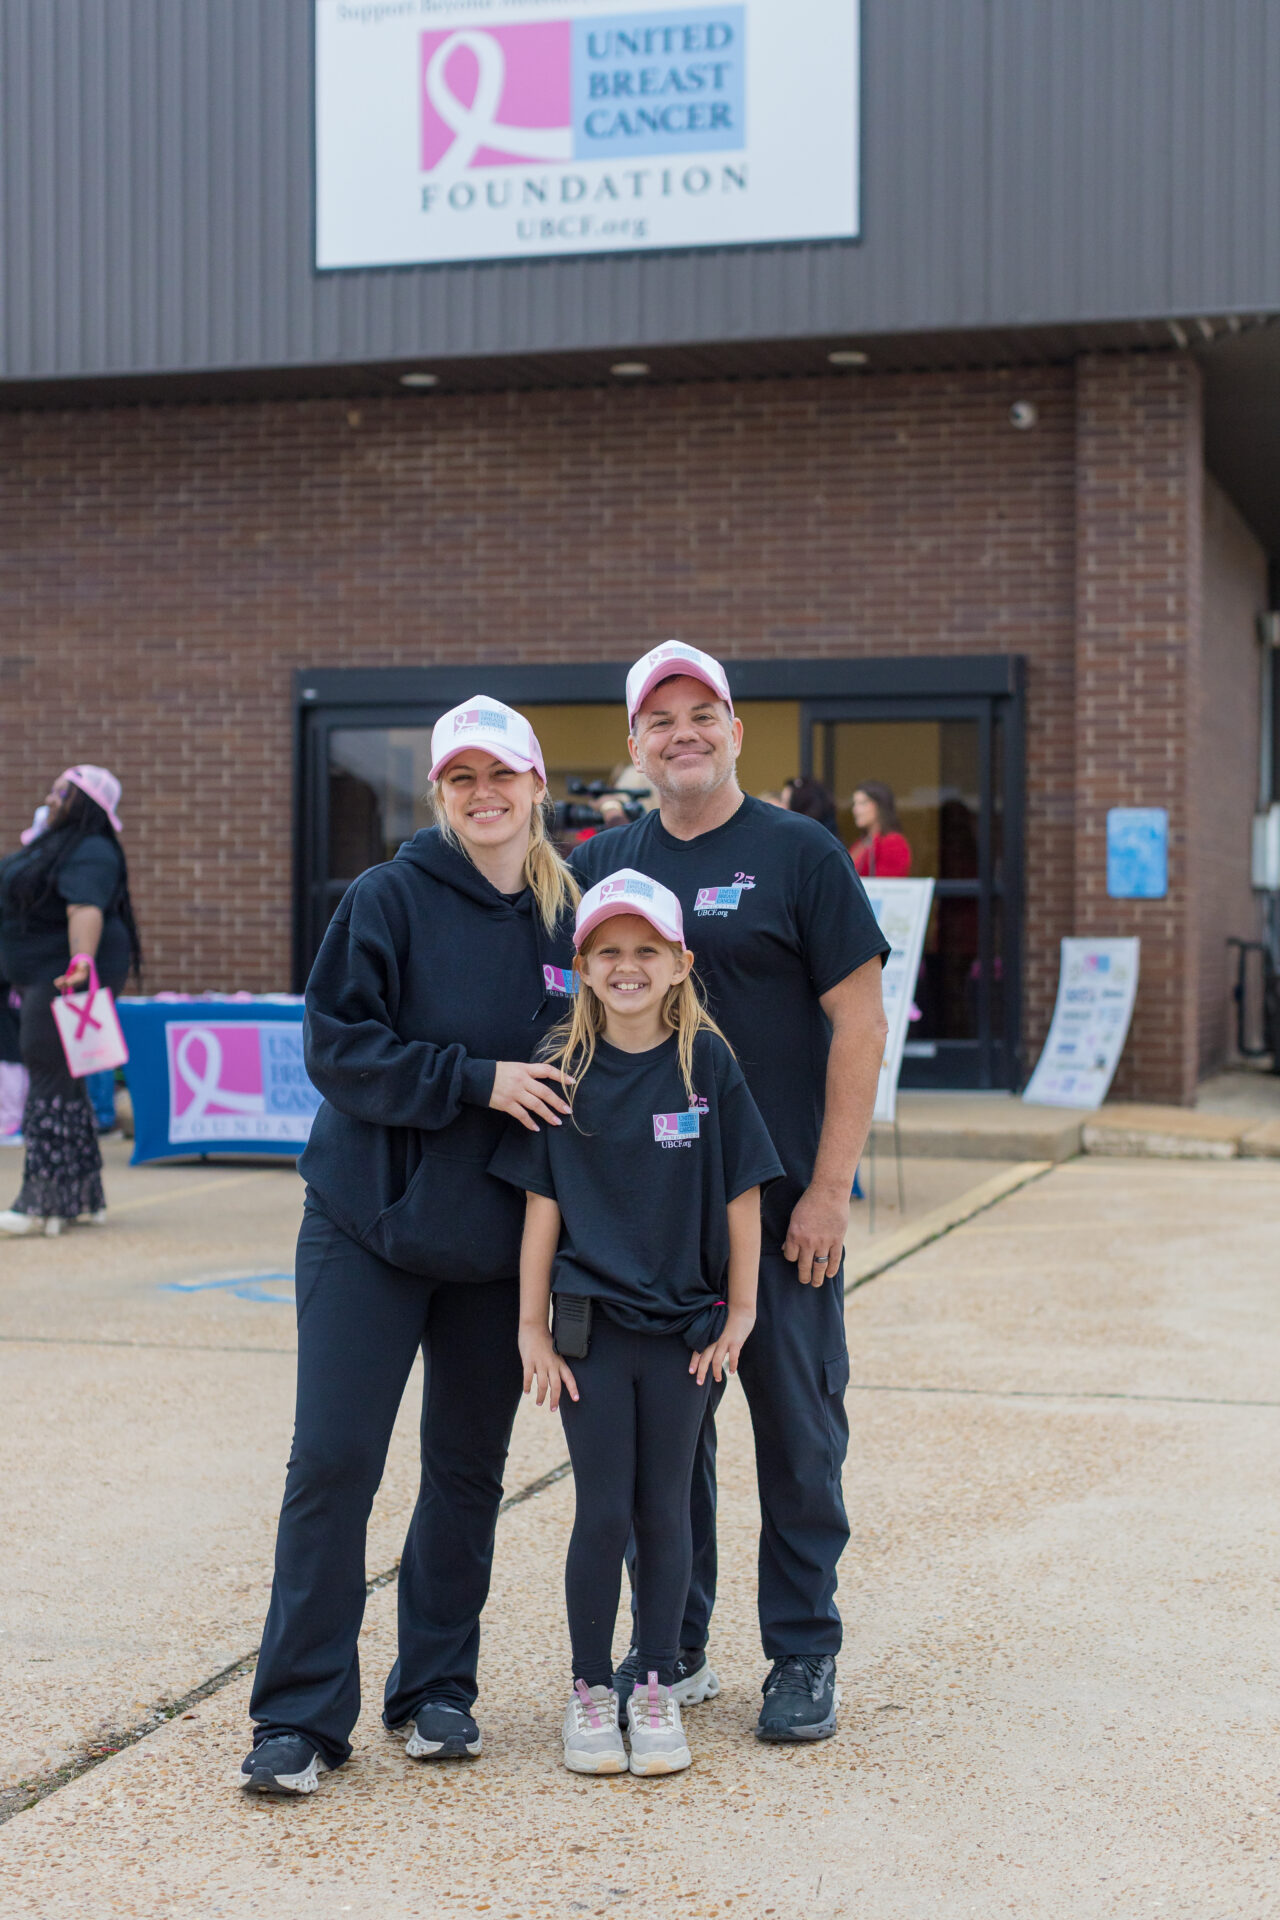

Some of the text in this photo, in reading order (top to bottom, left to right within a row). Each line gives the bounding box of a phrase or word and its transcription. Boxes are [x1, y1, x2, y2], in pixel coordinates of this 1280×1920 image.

[586, 22, 735, 61] UNITED
[588, 60, 732, 100] BREAST
[584, 101, 734, 140] CANCER
[420, 163, 749, 213] FOUNDATION
[516, 215, 649, 241] UBCF.org
[734, 871, 755, 890] 25
[697, 909, 729, 917] UBCF.org
[661, 1140, 692, 1149] UBCF.org
